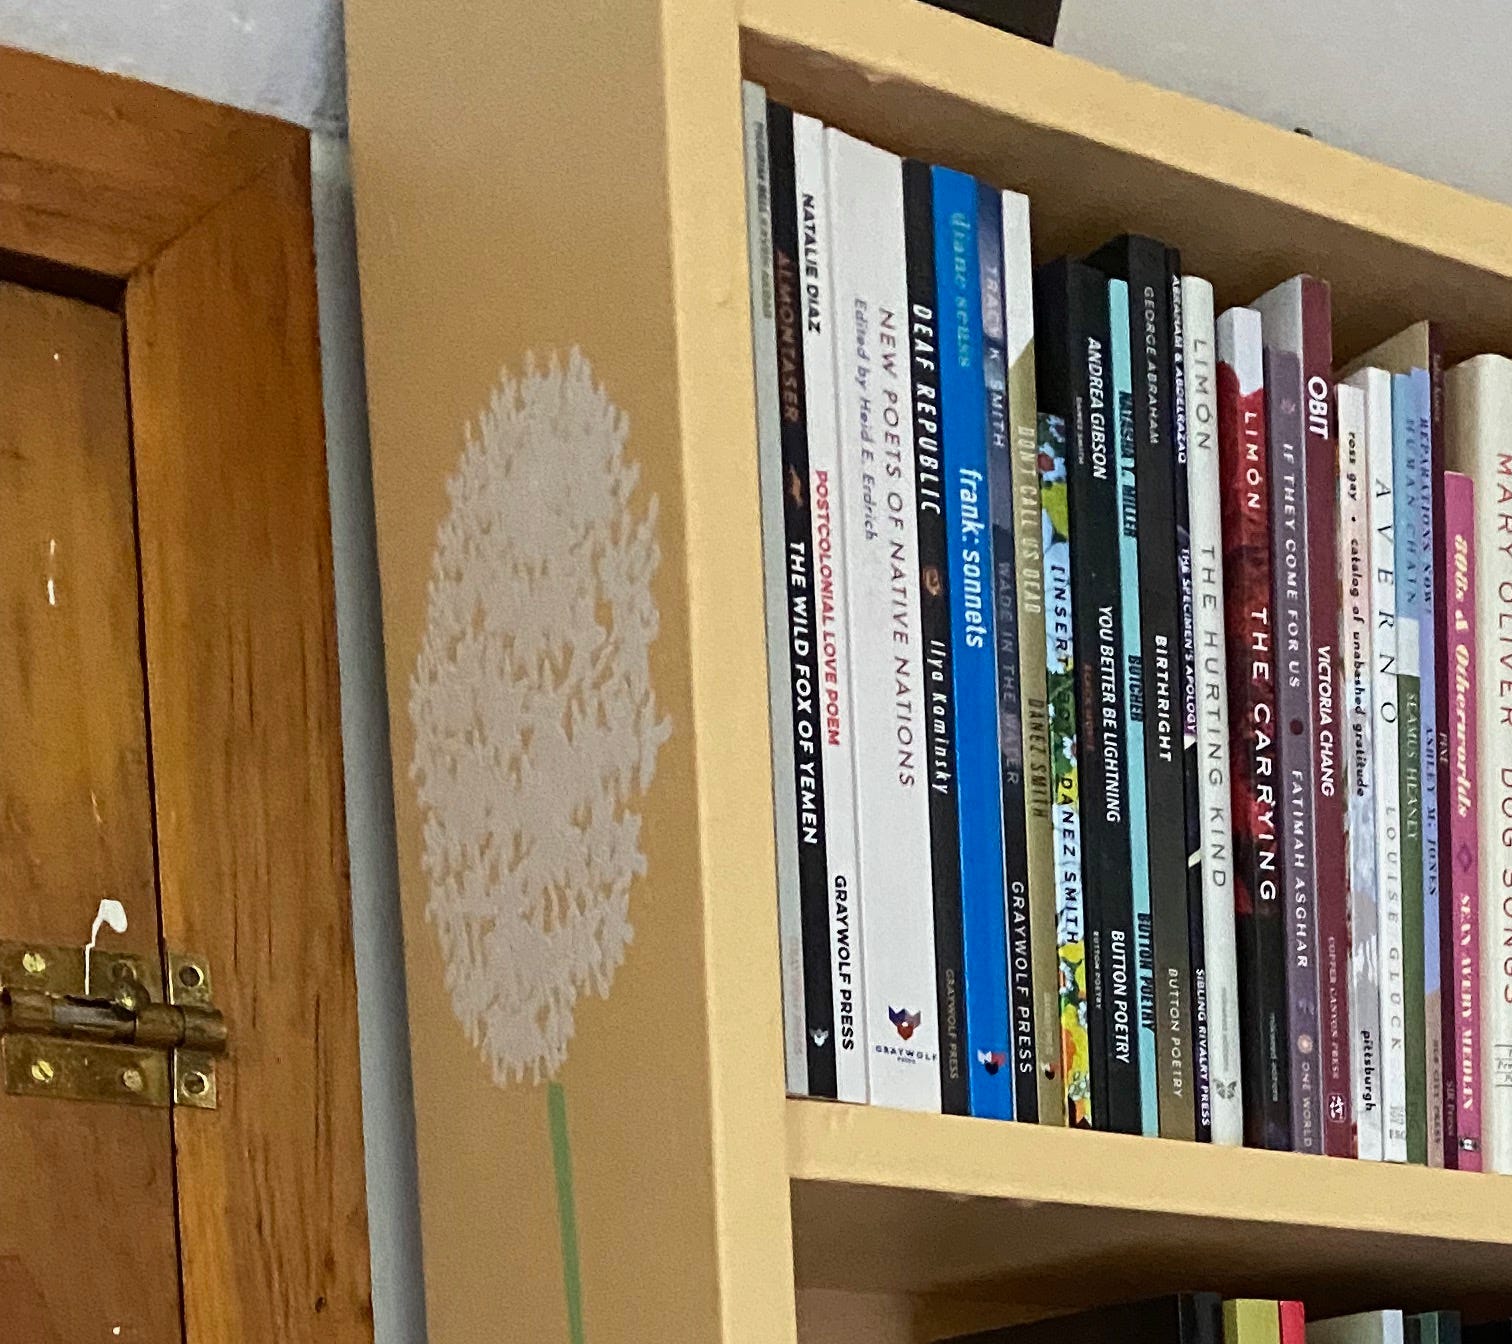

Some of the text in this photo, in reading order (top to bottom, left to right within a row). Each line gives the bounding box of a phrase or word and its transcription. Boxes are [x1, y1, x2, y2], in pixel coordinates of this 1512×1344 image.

[802, 195, 821, 334] NATALIE DIAZ
[853, 299, 877, 539] Edited by Heid E. Erdrich
[912, 304, 940, 514] DEAF REPUBLIC
[1087, 338, 1108, 479] ANDREA GIBSON
[1193, 339, 1214, 452] LIMÓN
[1308, 376, 1329, 440] OBIT
[816, 471, 841, 745] POSTCOLONIAL LOVE POEM
[879, 309, 914, 787] NEW POETS OF NATIVE NATIONS
[959, 468, 987, 647] frank: sonnets
[1283, 443, 1301, 687] IF THEY COME FOR US
[790, 542, 818, 843] THE WILD FOX OF YEMEN
[930, 640, 952, 794] Ilya Kaminsky
[1098, 607, 1122, 822] YOU BETTER BE LIGHTNING
[1154, 635, 1173, 761] BIRTHRIGHT
[1251, 608, 1275, 901] THE CARRYING
[1317, 645, 1335, 797] VICTORIA CHANG
[1290, 770, 1309, 967] FATIMAH ASGHAR
[1360, 1030, 1376, 1111] pittsburgh
